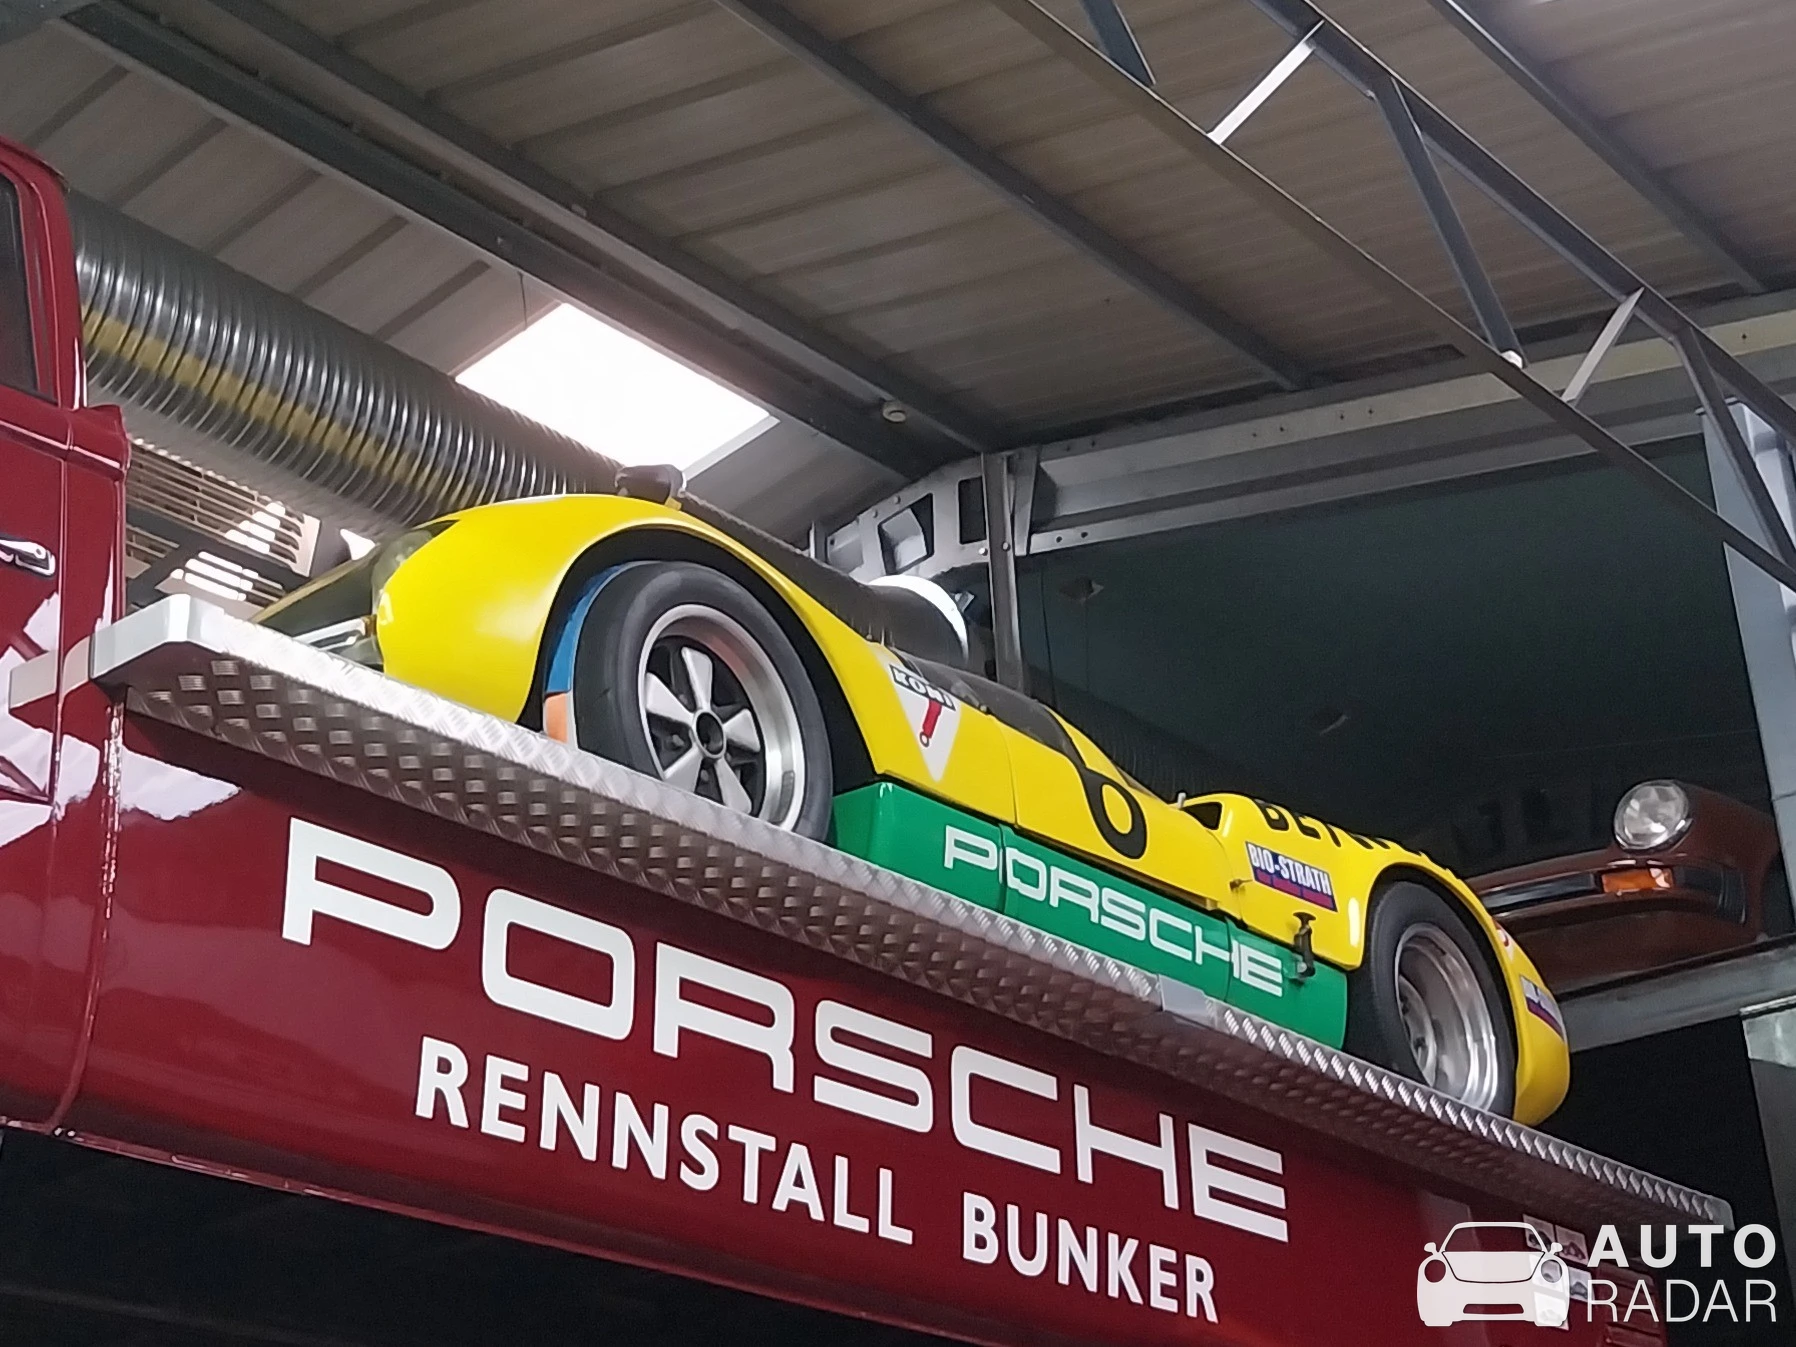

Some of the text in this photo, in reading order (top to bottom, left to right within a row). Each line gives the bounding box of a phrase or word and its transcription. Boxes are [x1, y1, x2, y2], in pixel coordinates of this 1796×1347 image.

[892, 667, 953, 707] KONI
[944, 825, 1283, 997] PORSCHE
[1249, 844, 1332, 896] BIO-STRATH
[282, 817, 1288, 1242] PORSCHE
[415, 1036, 1218, 1323] RENNSTALL BUNKER
